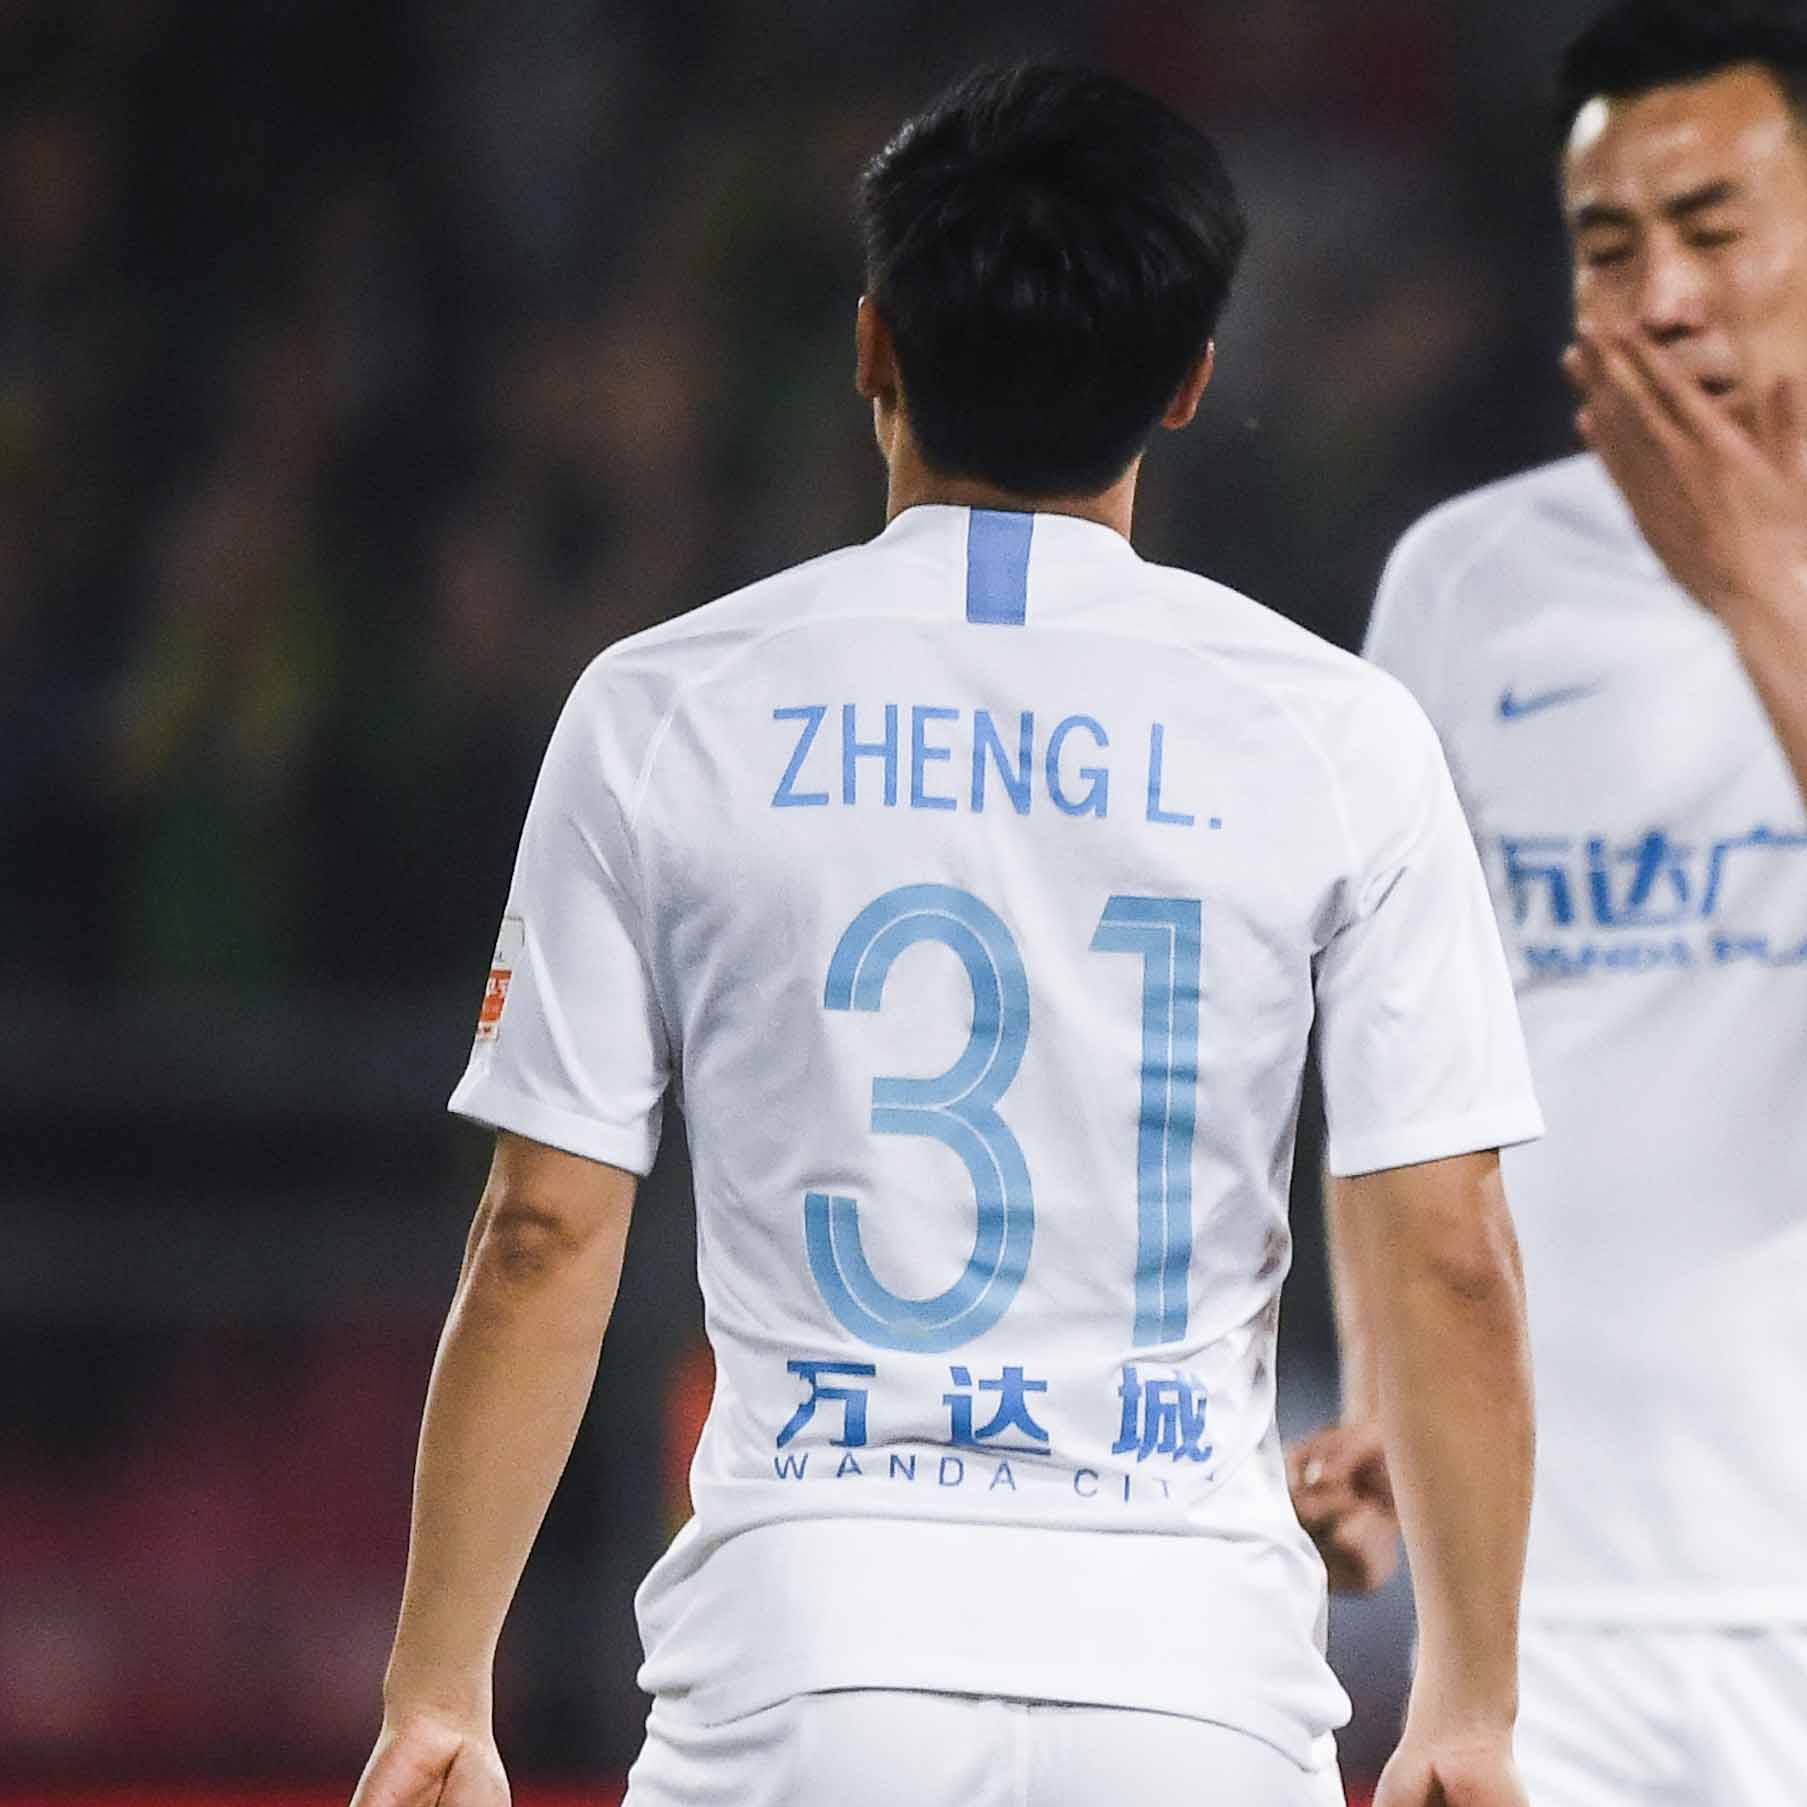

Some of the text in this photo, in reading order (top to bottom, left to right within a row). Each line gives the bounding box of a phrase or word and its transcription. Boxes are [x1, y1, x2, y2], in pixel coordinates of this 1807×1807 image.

[771, 704, 1223, 829] ZHENG L.
[804, 882, 1204, 1354] 31
[776, 1359, 1213, 1463] 万达城
[774, 1452, 1215, 1503] WANDA CIT
